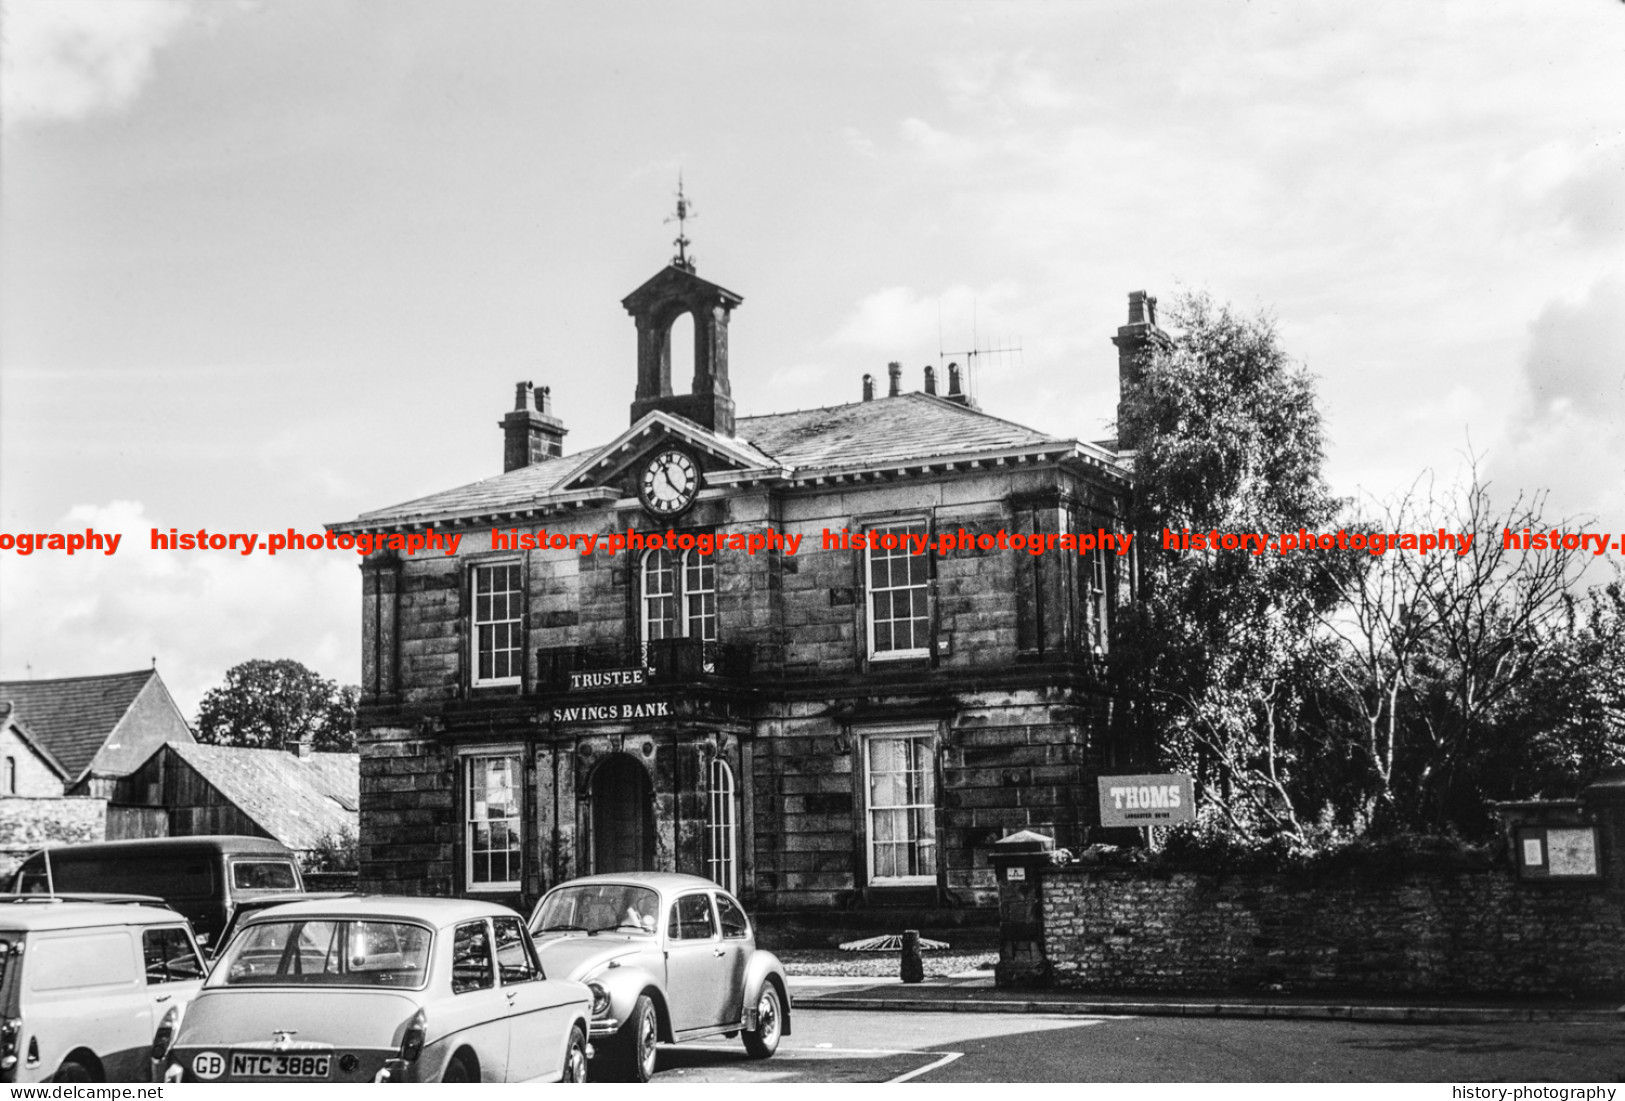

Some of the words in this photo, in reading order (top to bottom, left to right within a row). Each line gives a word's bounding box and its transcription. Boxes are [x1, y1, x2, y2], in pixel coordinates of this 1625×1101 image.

[571, 670, 643, 688] TRUSTEE
[553, 705, 618, 722] SAVINGS
[1109, 785, 1182, 809] THOMS
[195, 1056, 222, 1074] GB
[233, 1055, 272, 1074] NTC
[275, 1056, 328, 1075] 388G
